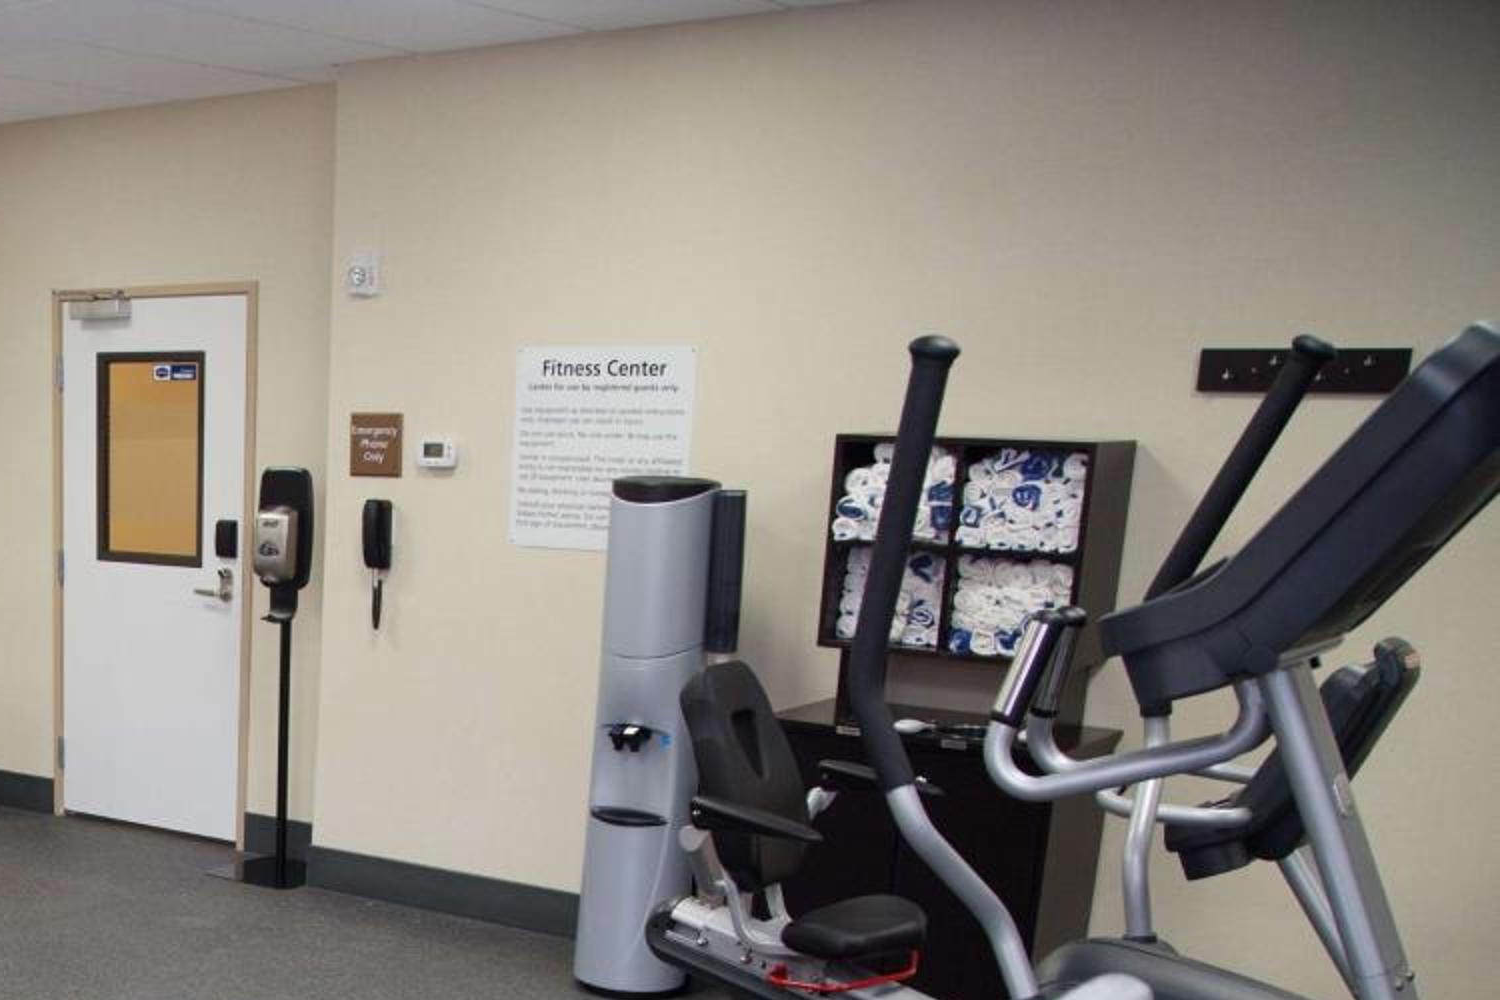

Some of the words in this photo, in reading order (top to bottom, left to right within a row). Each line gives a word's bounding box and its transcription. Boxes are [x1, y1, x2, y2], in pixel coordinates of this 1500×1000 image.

[542, 359, 601, 377] Fitness
[607, 359, 667, 377] Center
[363, 451, 385, 464] Only
